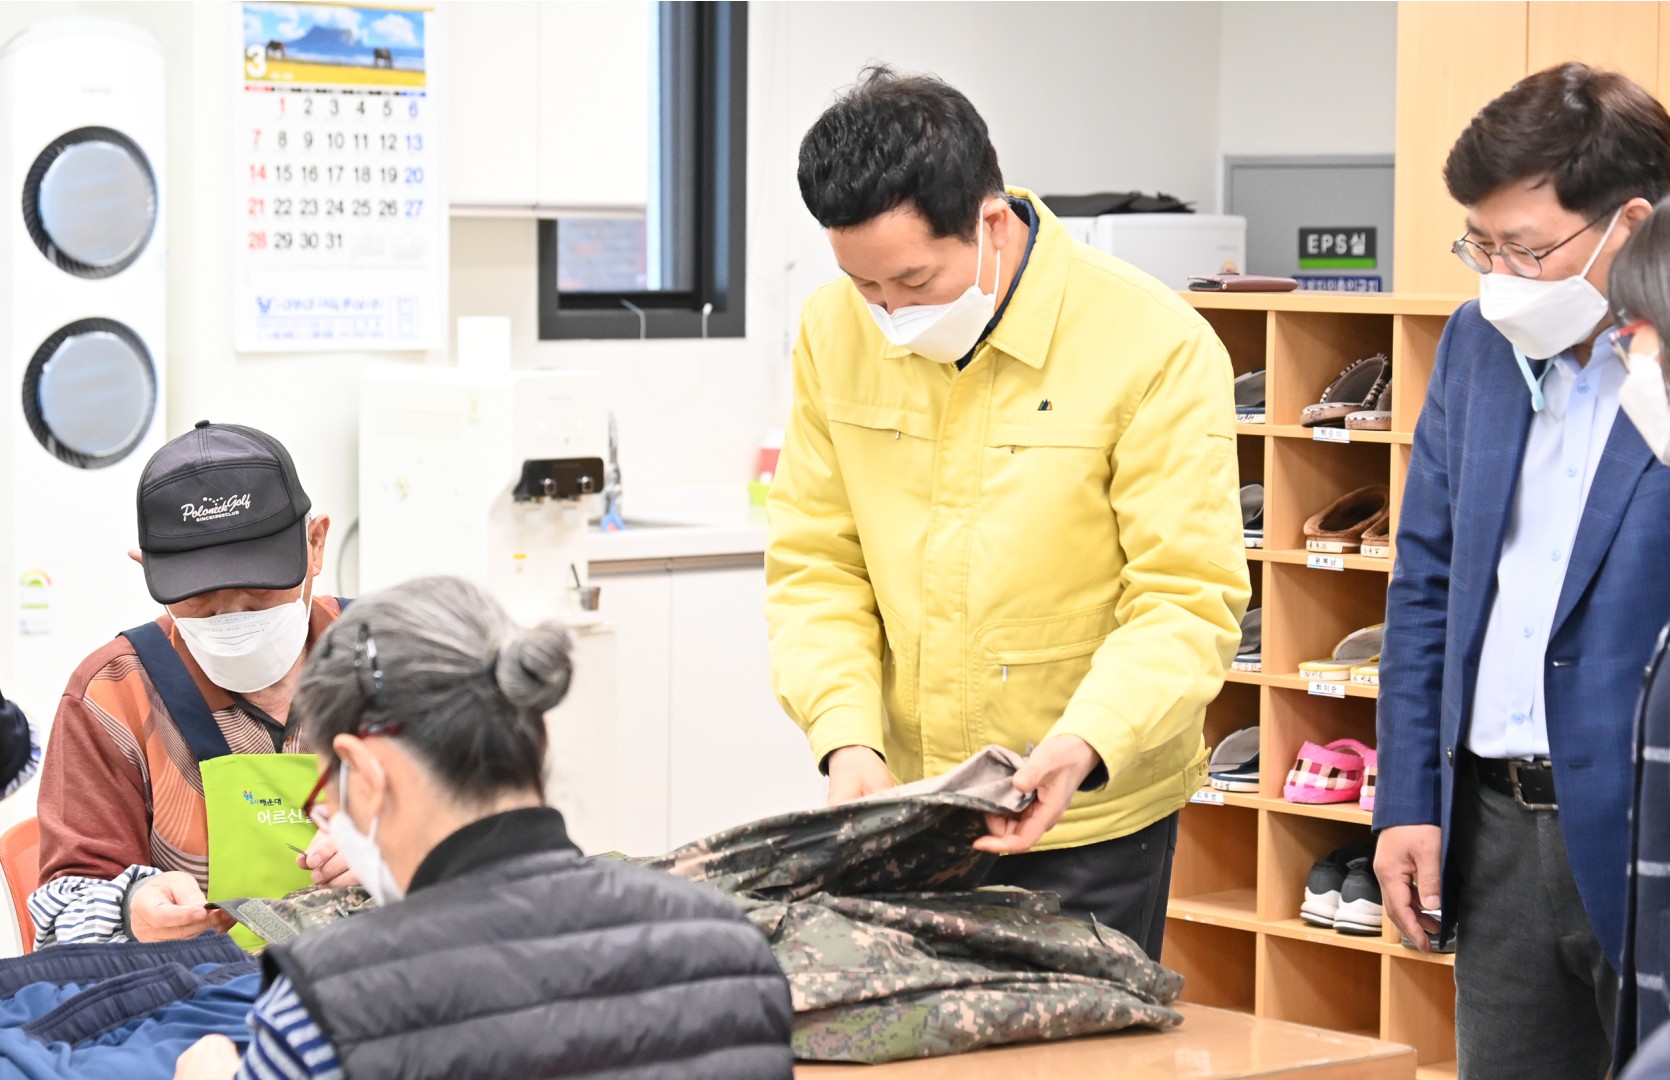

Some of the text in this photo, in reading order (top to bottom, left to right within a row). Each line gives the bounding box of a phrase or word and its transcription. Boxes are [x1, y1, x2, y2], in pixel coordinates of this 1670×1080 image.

[246, 44, 267, 79] 3
[280, 97, 418, 118] 1 2 3 4 5 6
[252, 129, 423, 151] 7 8 9 10 11 12 13
[250, 164, 424, 185] 14 15 16 17 18 19 20
[249, 197, 424, 217] 21 22 23 24 25 26 27
[249, 231, 267, 250] 28
[275, 232, 293, 249] 29
[301, 232, 319, 249] 30
[327, 233, 342, 249] 31
[1306, 233, 1347, 255] EPS
